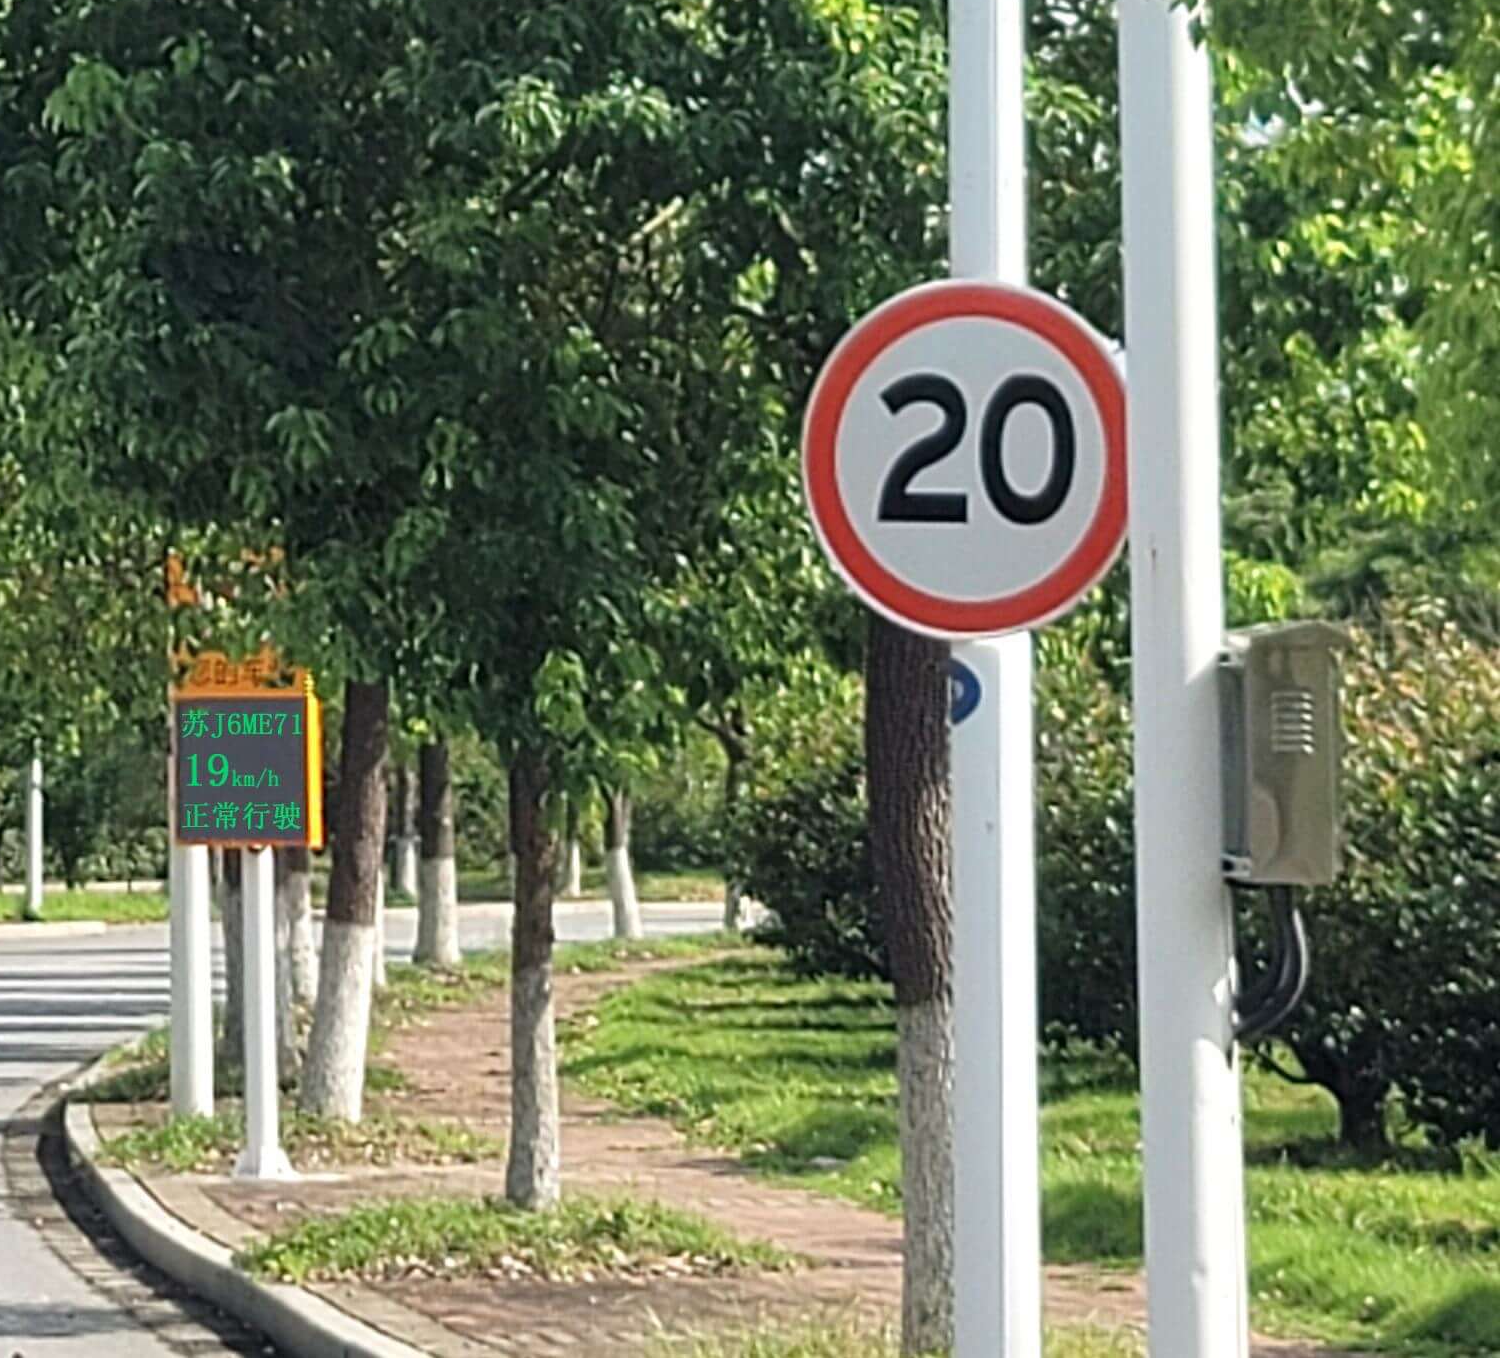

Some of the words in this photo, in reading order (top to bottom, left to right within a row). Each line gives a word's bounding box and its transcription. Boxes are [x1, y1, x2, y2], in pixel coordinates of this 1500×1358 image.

[878, 373, 1076, 525] 20
[183, 708, 302, 738] 苏J6ME71
[186, 753, 229, 787] 19
[231, 768, 280, 787] km/h
[182, 802, 301, 830] 正常行驶
